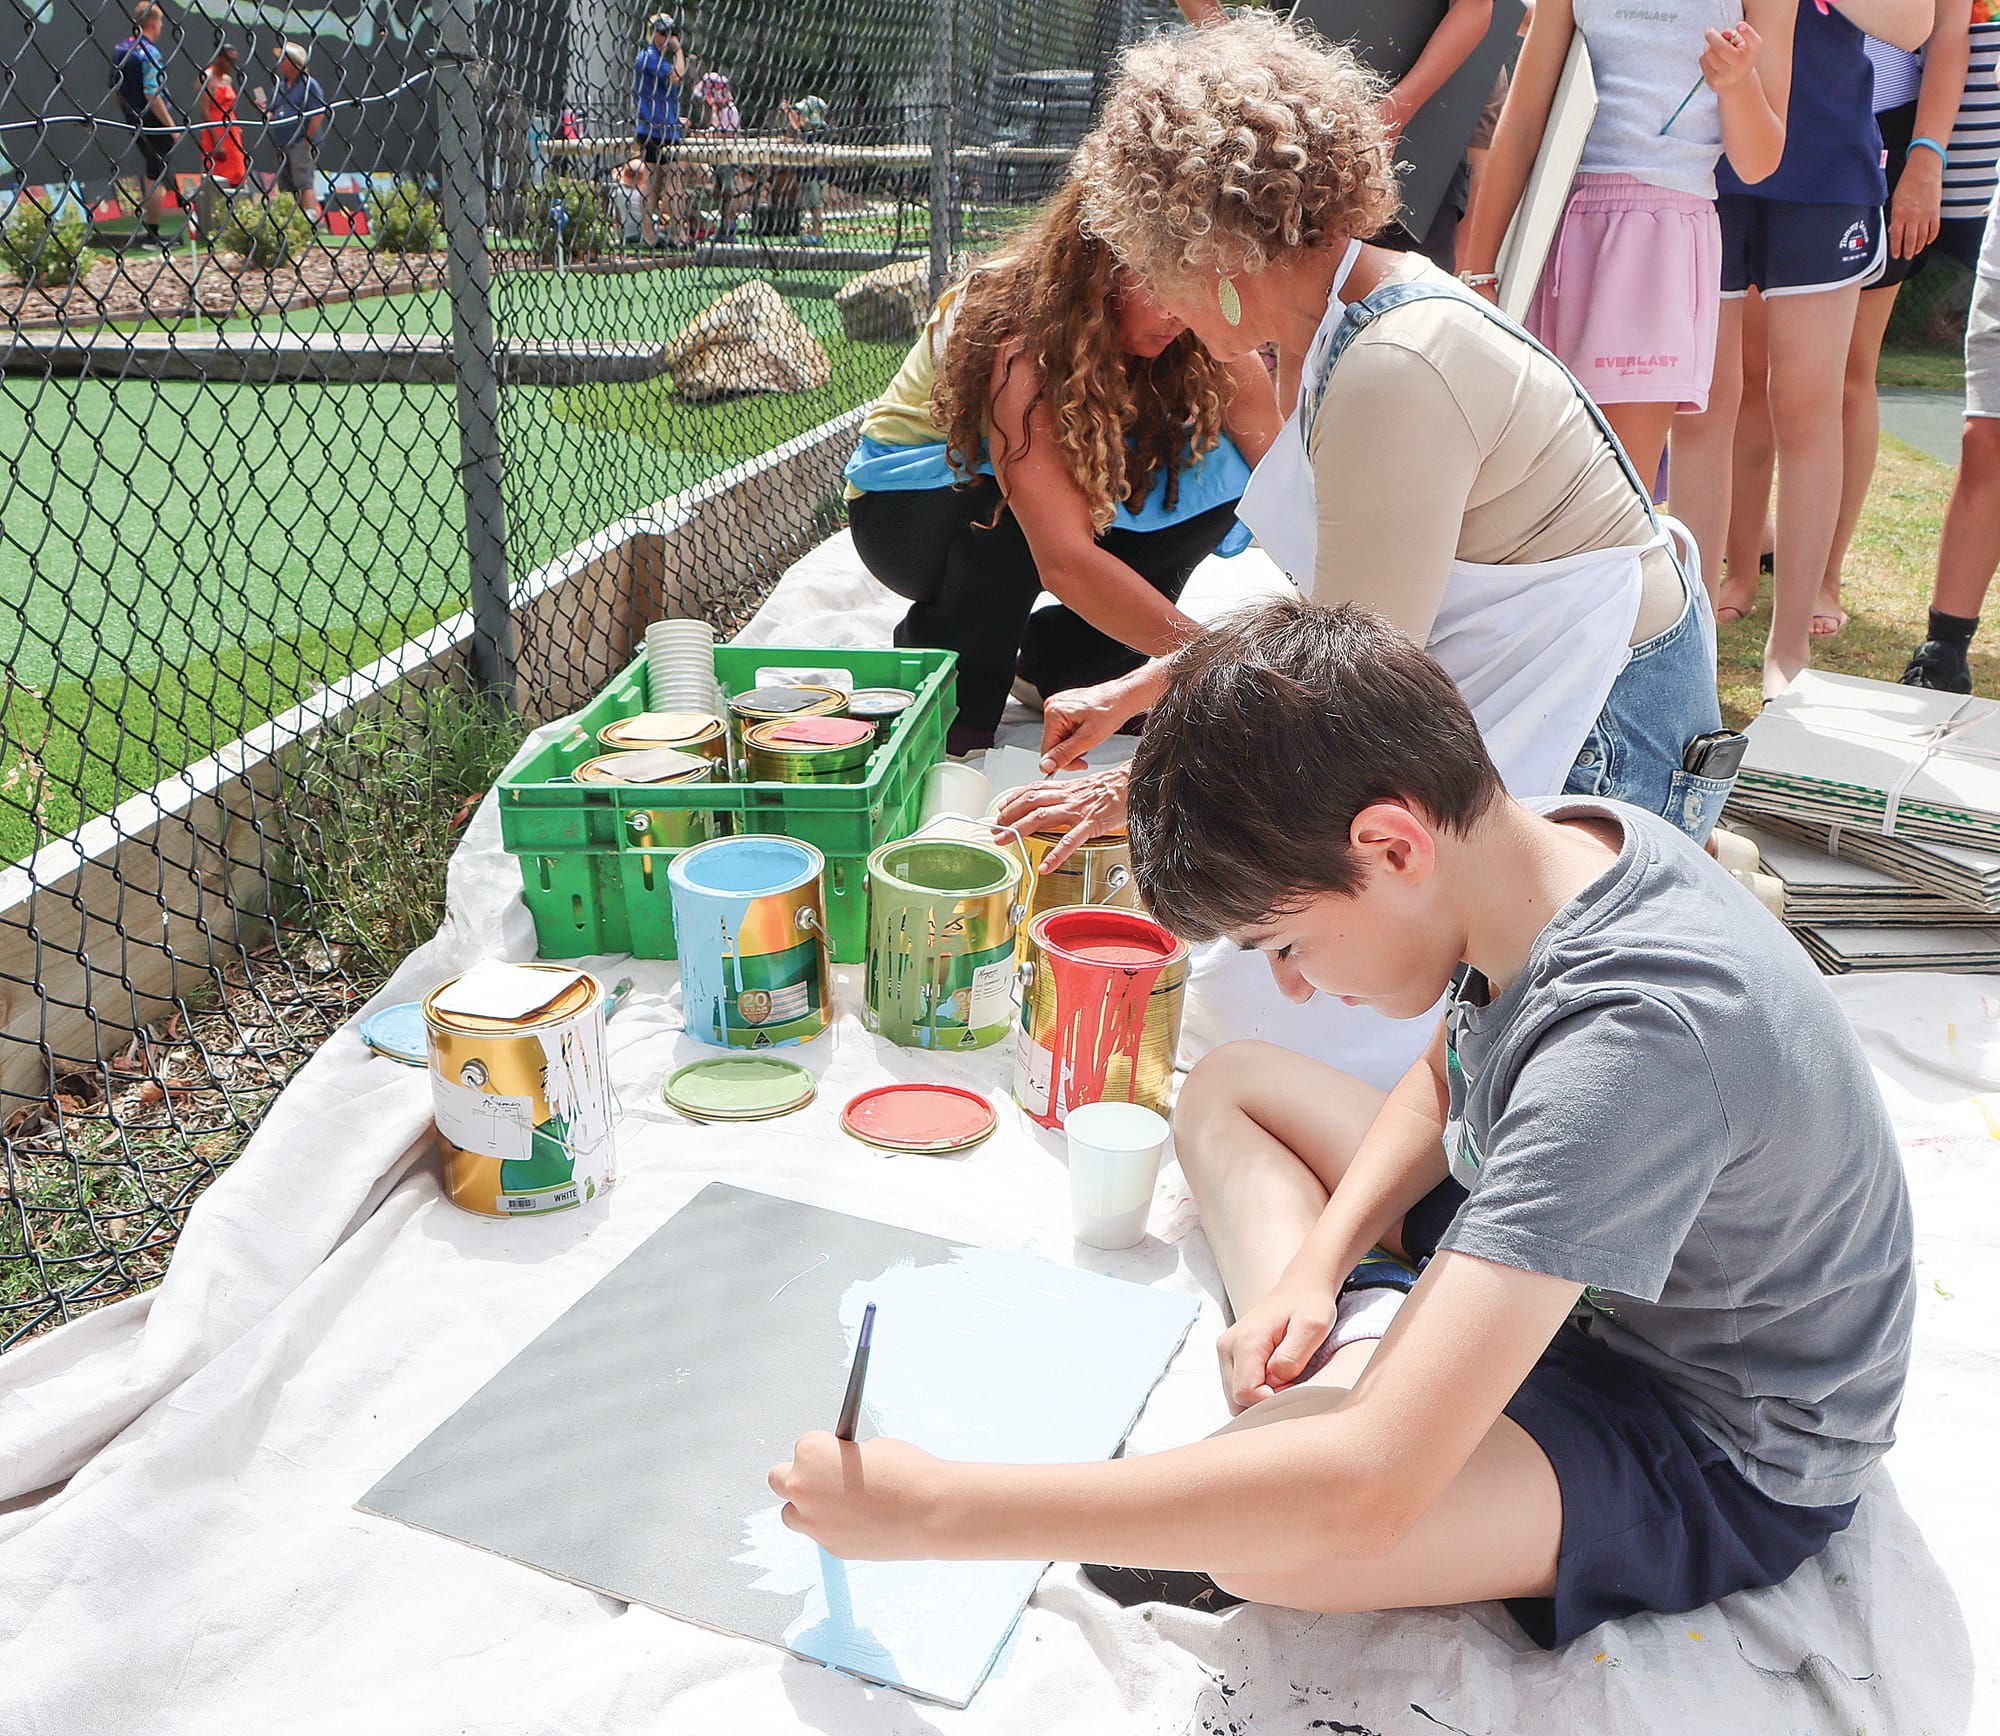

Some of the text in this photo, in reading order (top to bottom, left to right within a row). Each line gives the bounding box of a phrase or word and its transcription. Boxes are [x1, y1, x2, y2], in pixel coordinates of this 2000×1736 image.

[1614, 9, 1678, 24] EVERLAST
[1594, 355, 1679, 368] EVERLAST
[742, 992, 768, 1007] 20
[554, 1189, 577, 1202] WHITE
